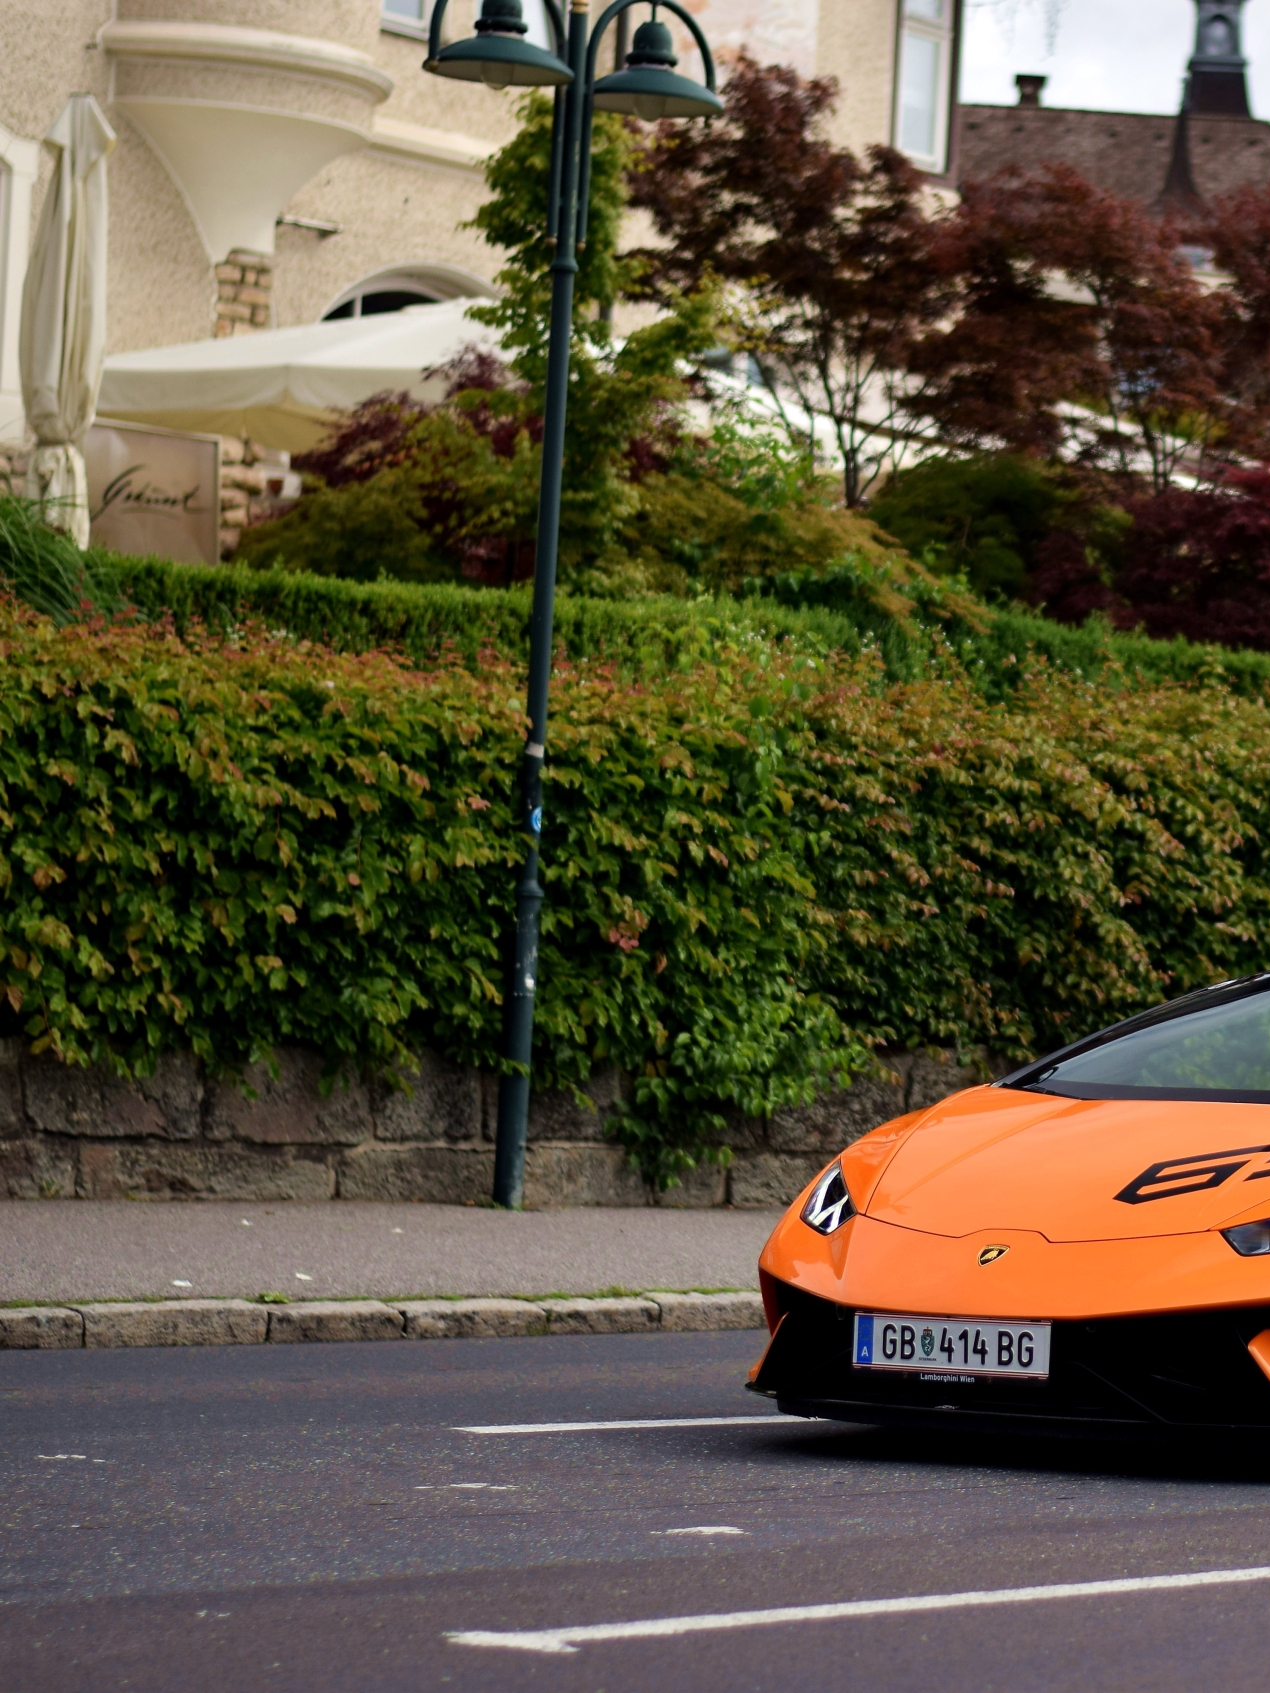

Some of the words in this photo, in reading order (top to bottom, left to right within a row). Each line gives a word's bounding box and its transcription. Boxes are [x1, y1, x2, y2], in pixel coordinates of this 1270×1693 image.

[882, 1323, 916, 1359] GB
[940, 1327, 989, 1365] 414
[998, 1329, 1034, 1367] BG
[861, 1346, 869, 1357] A
[920, 1373, 959, 1382] Lamborghini
